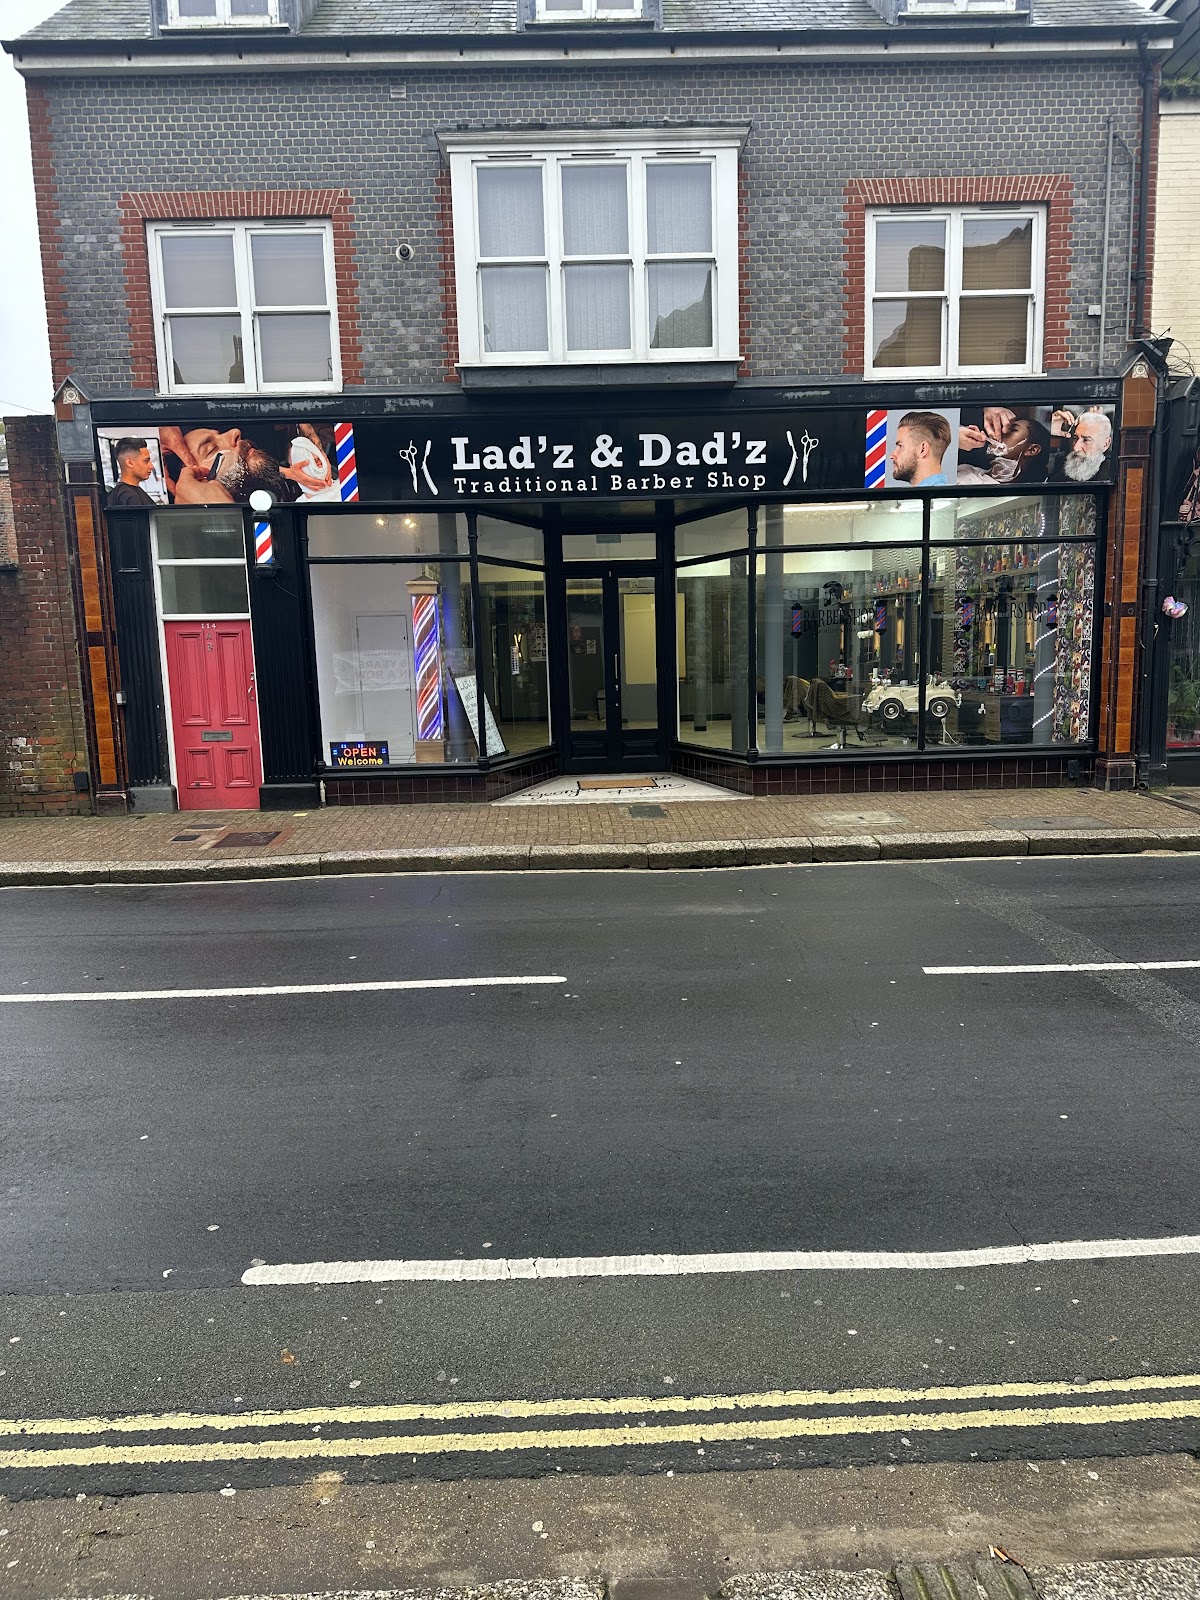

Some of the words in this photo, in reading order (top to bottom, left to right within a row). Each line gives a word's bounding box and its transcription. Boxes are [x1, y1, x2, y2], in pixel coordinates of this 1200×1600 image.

[451, 436, 574, 470] Lad'z
[591, 434, 623, 468] &
[638, 431, 767, 467] Dad'z
[454, 475, 598, 493] Traditional
[611, 473, 694, 490] Barber
[707, 471, 766, 490] Shop
[804, 607, 876, 632] BARBERSHOP
[338, 757, 383, 766] Welcome
[343, 748, 377, 757] OPEN
